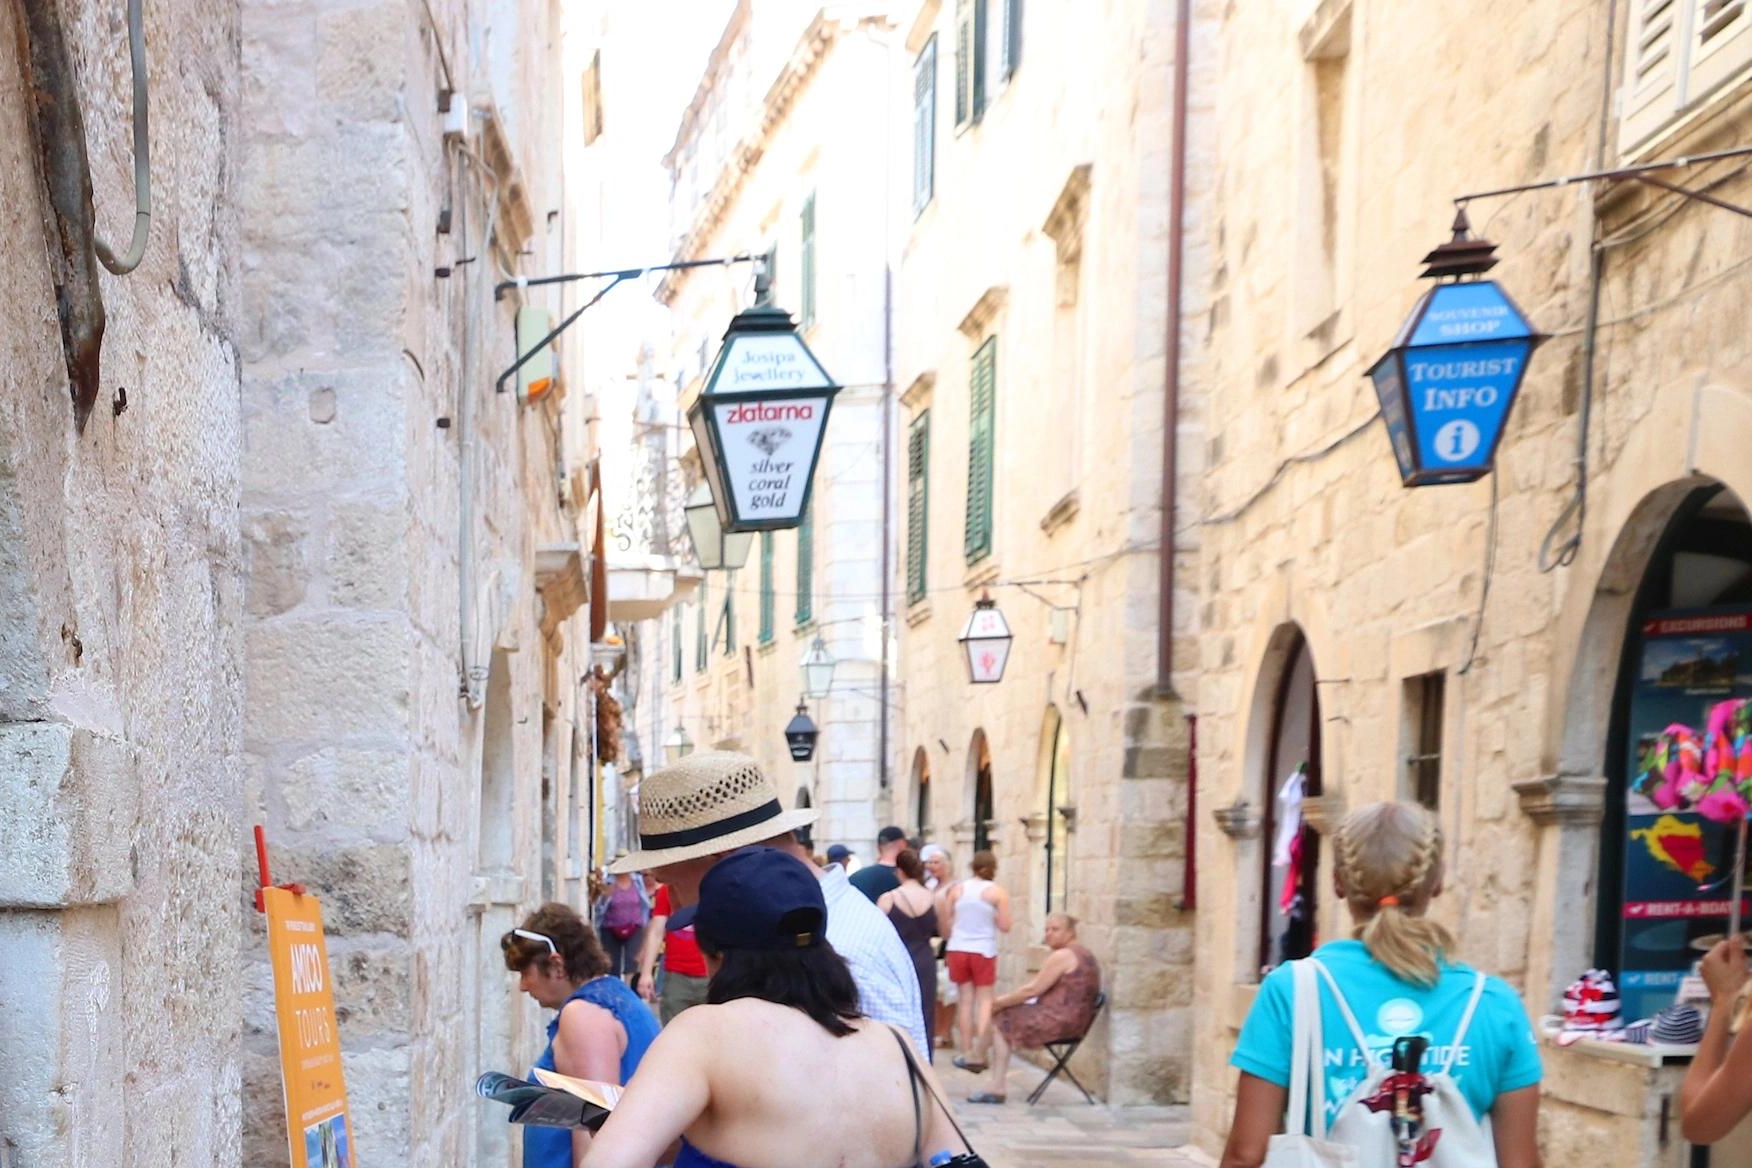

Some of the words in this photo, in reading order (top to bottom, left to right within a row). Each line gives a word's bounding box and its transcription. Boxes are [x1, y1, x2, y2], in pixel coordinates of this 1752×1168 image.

[1439, 320, 1501, 336] SHOP
[1411, 357, 1518, 382] TOURIST
[1423, 386, 1498, 411] INFO
[727, 401, 813, 424] zlatarna
[750, 458, 794, 474] silver
[748, 475, 791, 491] coral
[750, 492, 787, 510] gold
[296, 1006, 331, 1048] TOURS
